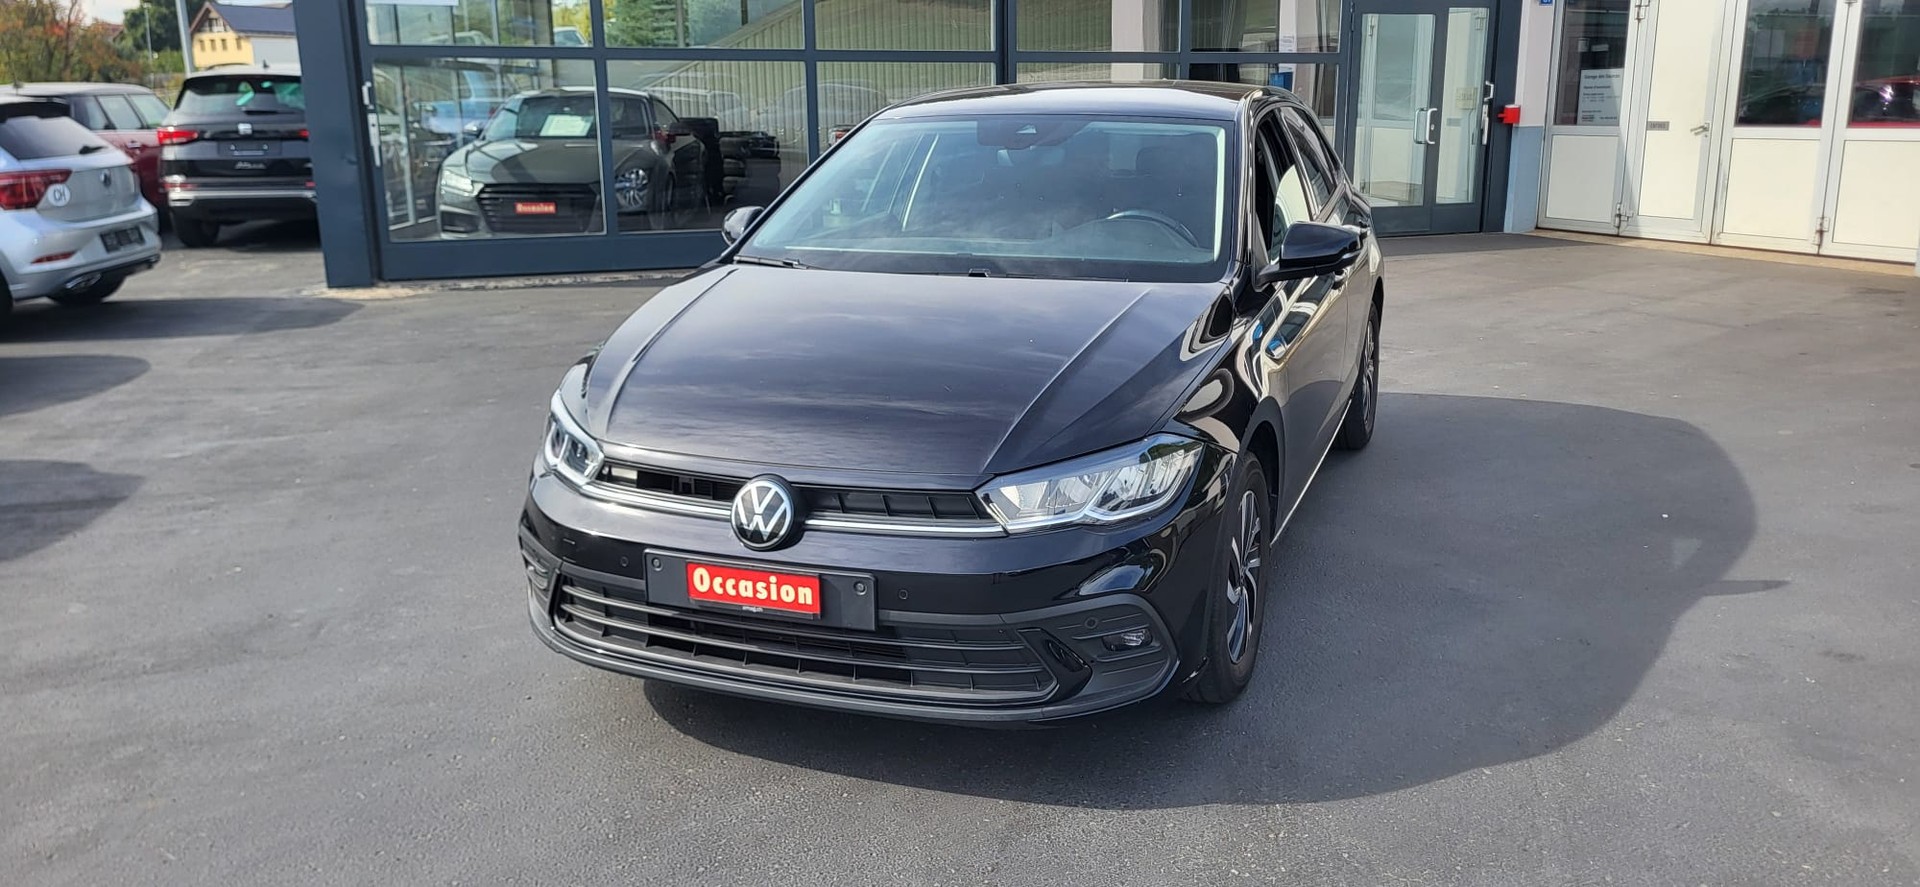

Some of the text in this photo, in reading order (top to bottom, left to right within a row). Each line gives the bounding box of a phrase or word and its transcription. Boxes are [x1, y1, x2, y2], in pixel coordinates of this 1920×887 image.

[515, 203, 556, 214] Occasion
[734, 481, 791, 545] VW
[693, 567, 813, 605] Occasion
